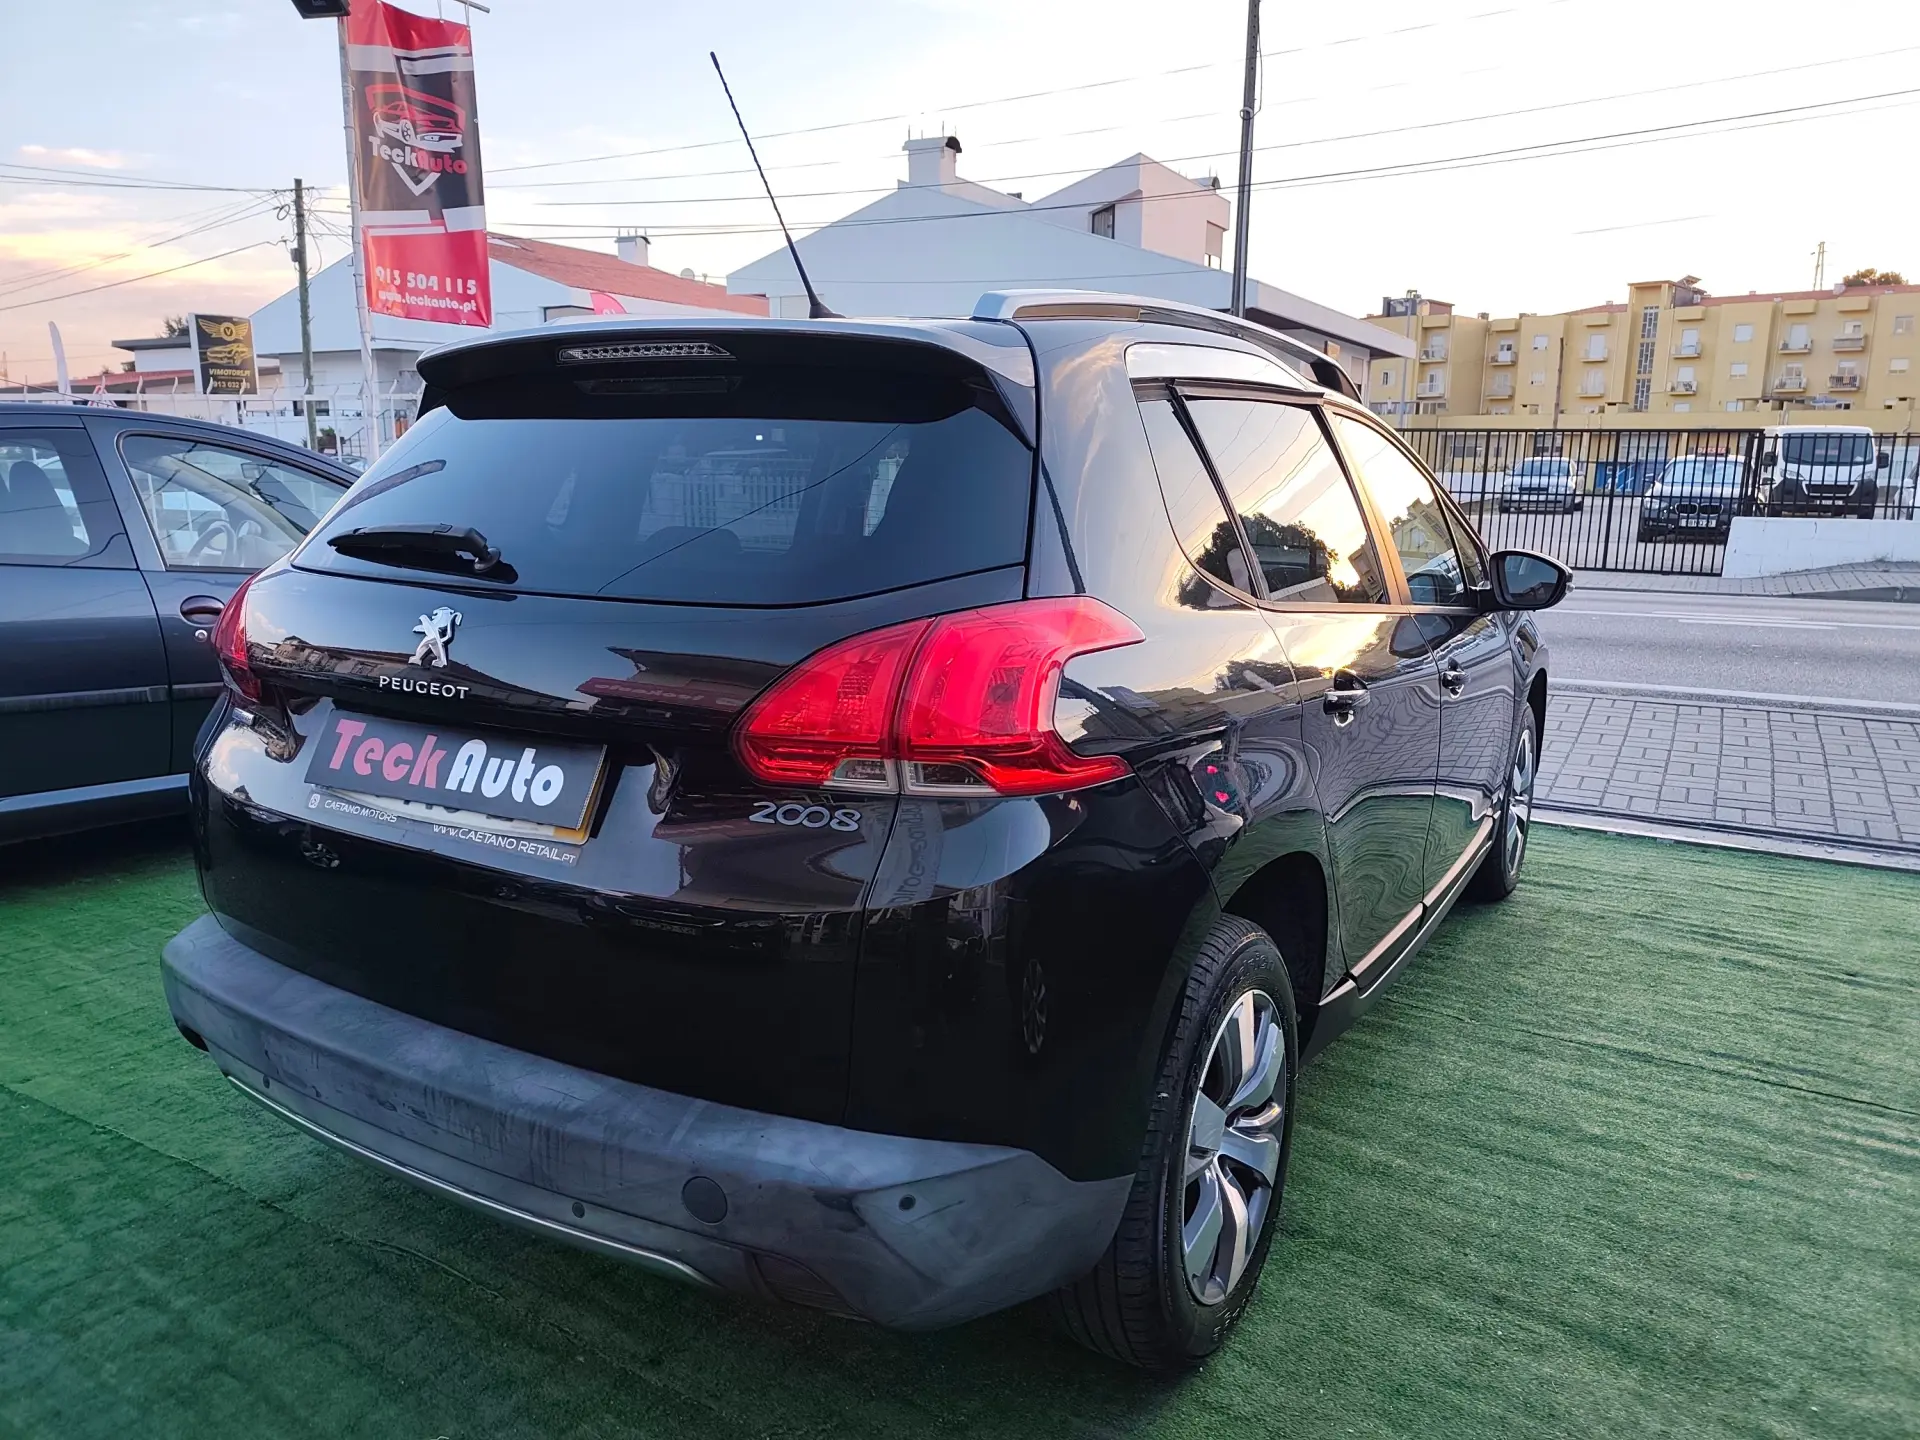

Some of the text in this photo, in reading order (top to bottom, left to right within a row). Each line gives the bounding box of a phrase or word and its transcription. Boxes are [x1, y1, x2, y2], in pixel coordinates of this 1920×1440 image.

[376, 266, 477, 296] 913 504 115
[379, 675, 469, 699] PEUGEOT
[324, 799, 398, 823] CAETANO MOTORS
[749, 801, 862, 832] 2008
